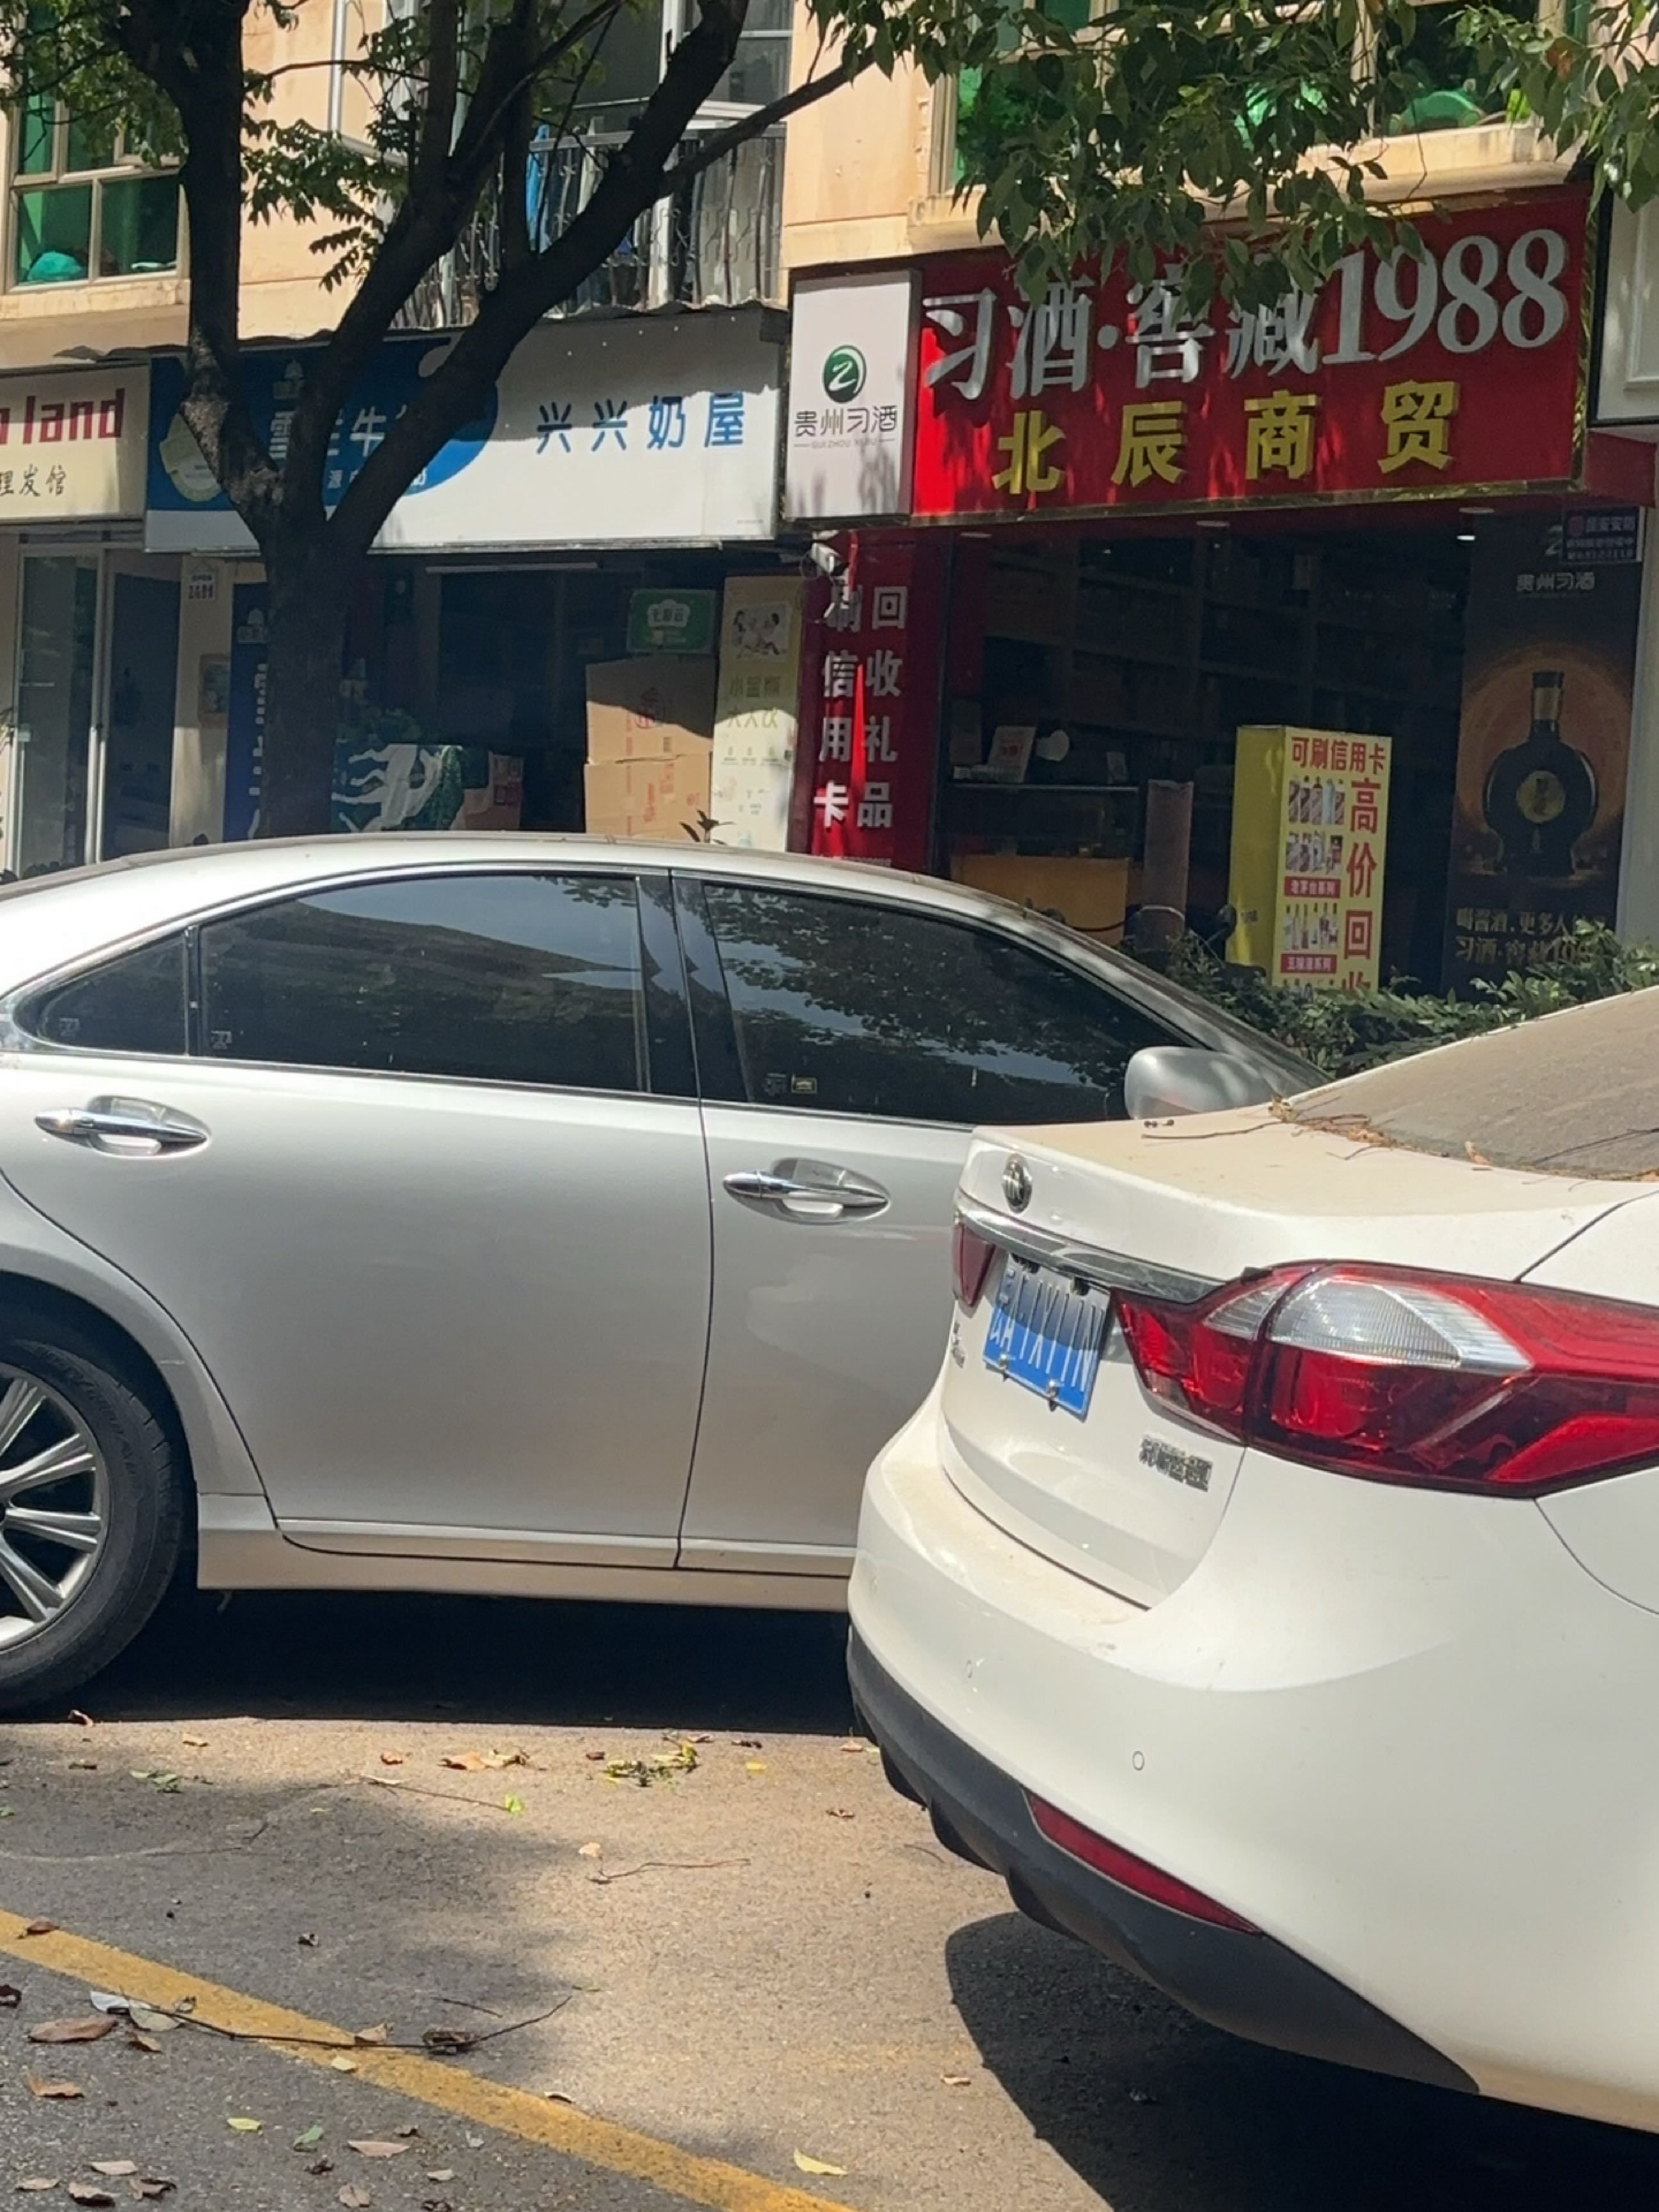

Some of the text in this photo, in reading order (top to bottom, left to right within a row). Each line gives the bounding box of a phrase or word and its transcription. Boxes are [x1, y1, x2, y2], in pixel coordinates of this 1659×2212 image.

[23, 389, 125, 445] land
[536, 391, 744, 454] 兴兴奶屋
[794, 405, 898, 437] 贵州习酒
[992, 380, 1460, 495] 北辰商贸
[858, 586, 908, 828] 回收礼品
[1290, 736, 1386, 774] 可刷信用卡
